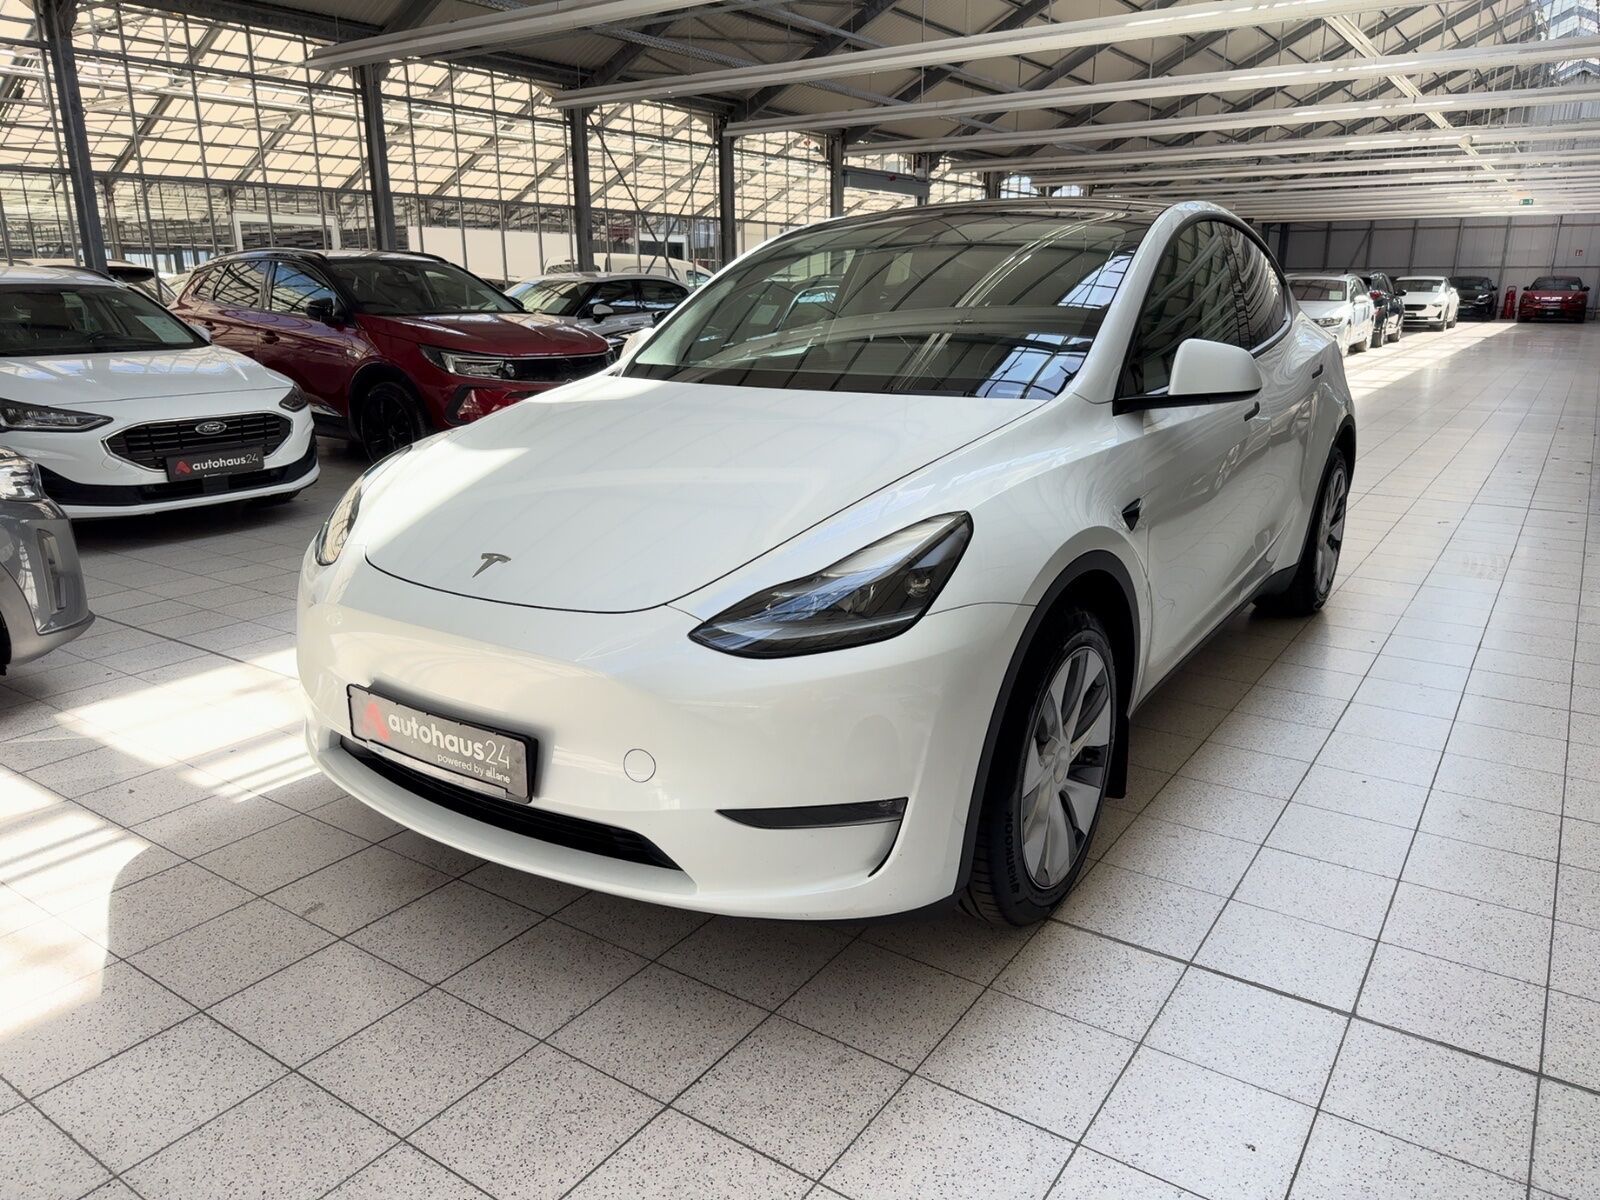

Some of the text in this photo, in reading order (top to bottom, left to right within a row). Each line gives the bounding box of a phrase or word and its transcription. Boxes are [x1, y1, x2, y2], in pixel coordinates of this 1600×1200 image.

[192, 453, 259, 471] autohaus24
[387, 713, 511, 770] autohaus24
[437, 754, 511, 784] powered by allane
